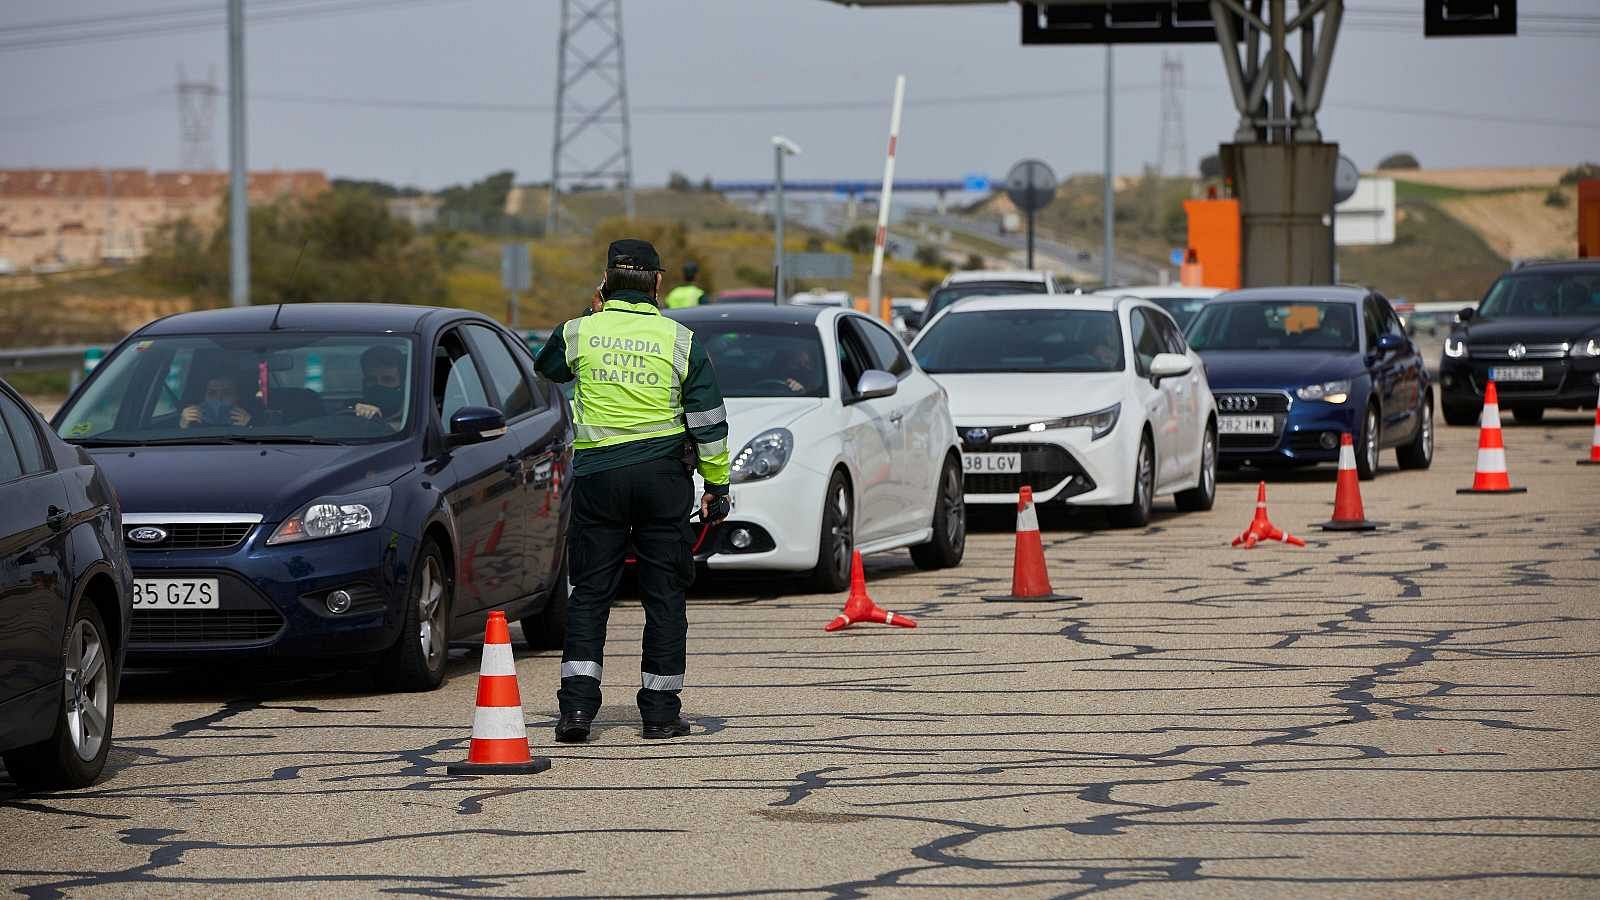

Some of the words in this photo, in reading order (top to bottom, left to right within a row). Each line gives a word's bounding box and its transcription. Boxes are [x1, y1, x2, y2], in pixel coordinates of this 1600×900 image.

[589, 335, 662, 354] GUARDIA
[602, 352, 646, 368] CIVIL
[591, 368, 659, 385] TRAFICO
[964, 456, 982, 470] 38
[987, 456, 1015, 470] LGV
[136, 529, 158, 539] Ford
[134, 583, 158, 604] 35
[167, 583, 212, 604] GZS
